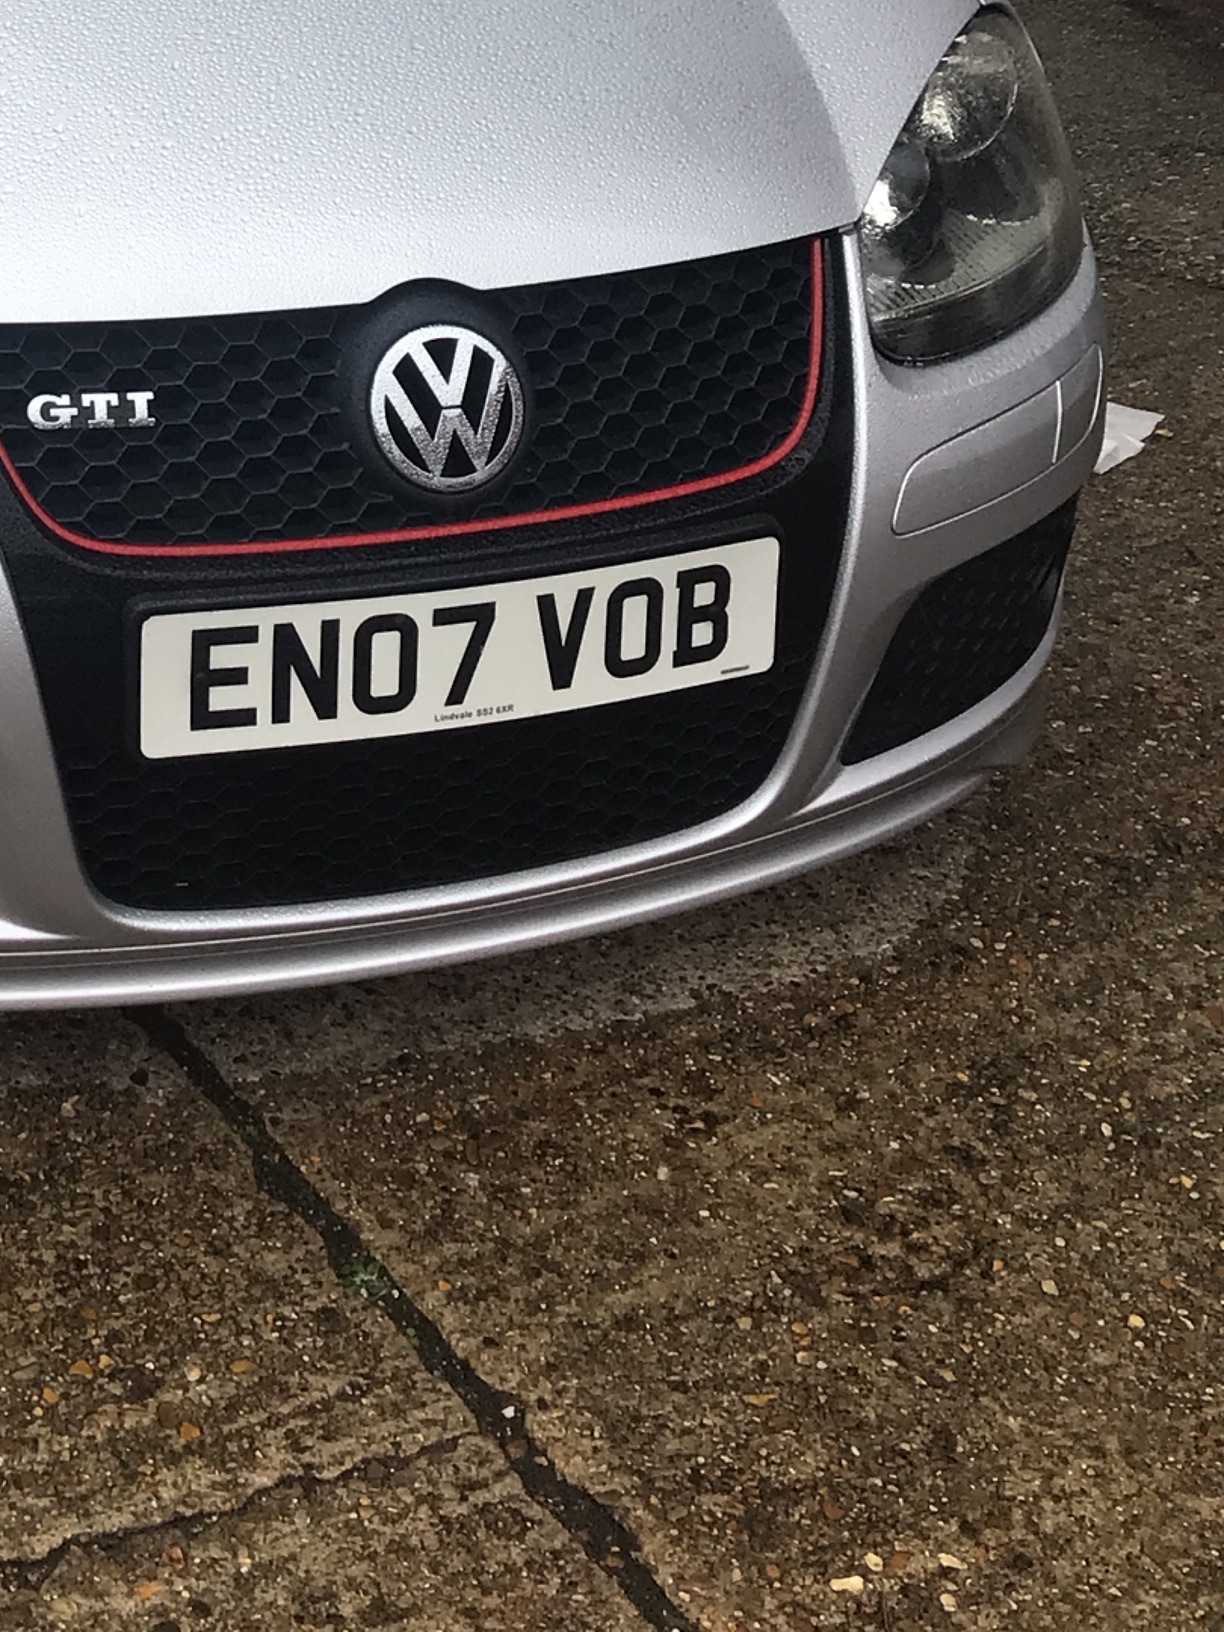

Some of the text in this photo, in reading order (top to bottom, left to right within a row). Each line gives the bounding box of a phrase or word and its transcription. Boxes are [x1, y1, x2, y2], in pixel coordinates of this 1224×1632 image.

[26, 391, 155, 430] GTI
[376, 330, 518, 488] VW
[537, 563, 731, 691] VOB
[434, 710, 473, 722] Lindvale
